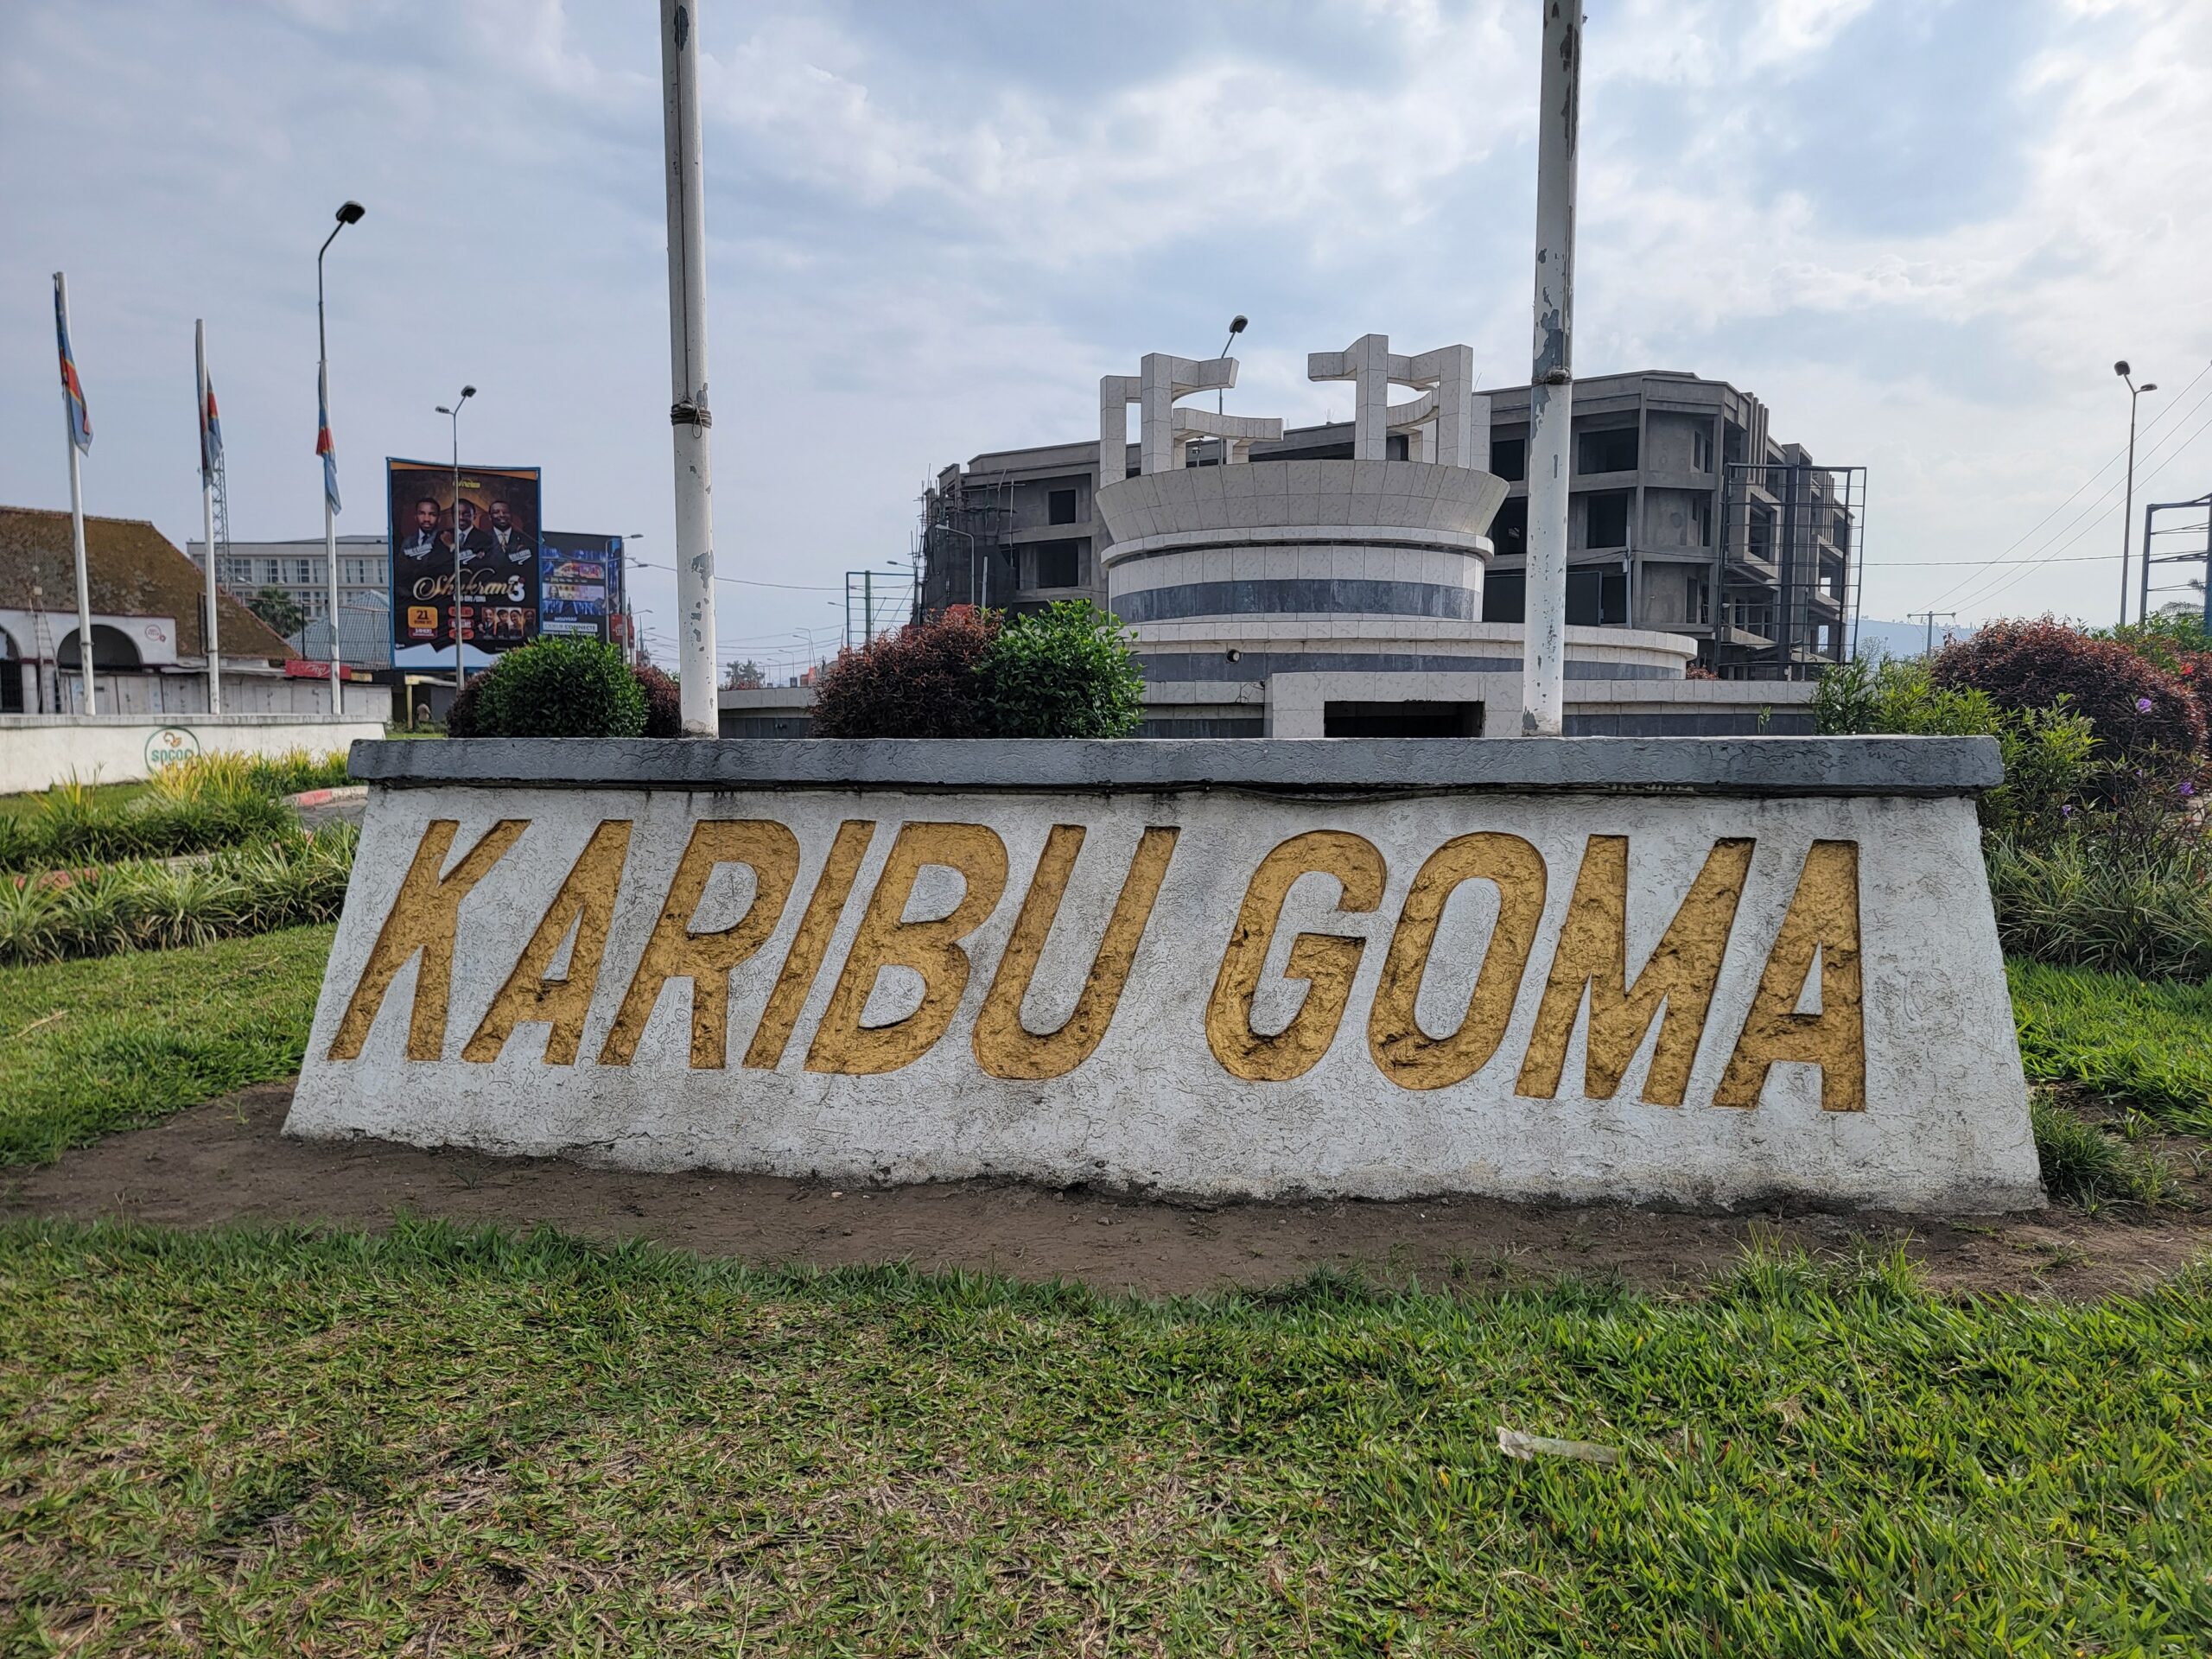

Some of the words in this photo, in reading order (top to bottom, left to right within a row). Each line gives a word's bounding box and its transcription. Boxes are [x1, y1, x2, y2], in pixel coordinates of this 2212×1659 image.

[416, 610, 429, 620] 21
[326, 819, 1182, 1081] KARIBU
[1205, 830, 1867, 1113] GOMA
